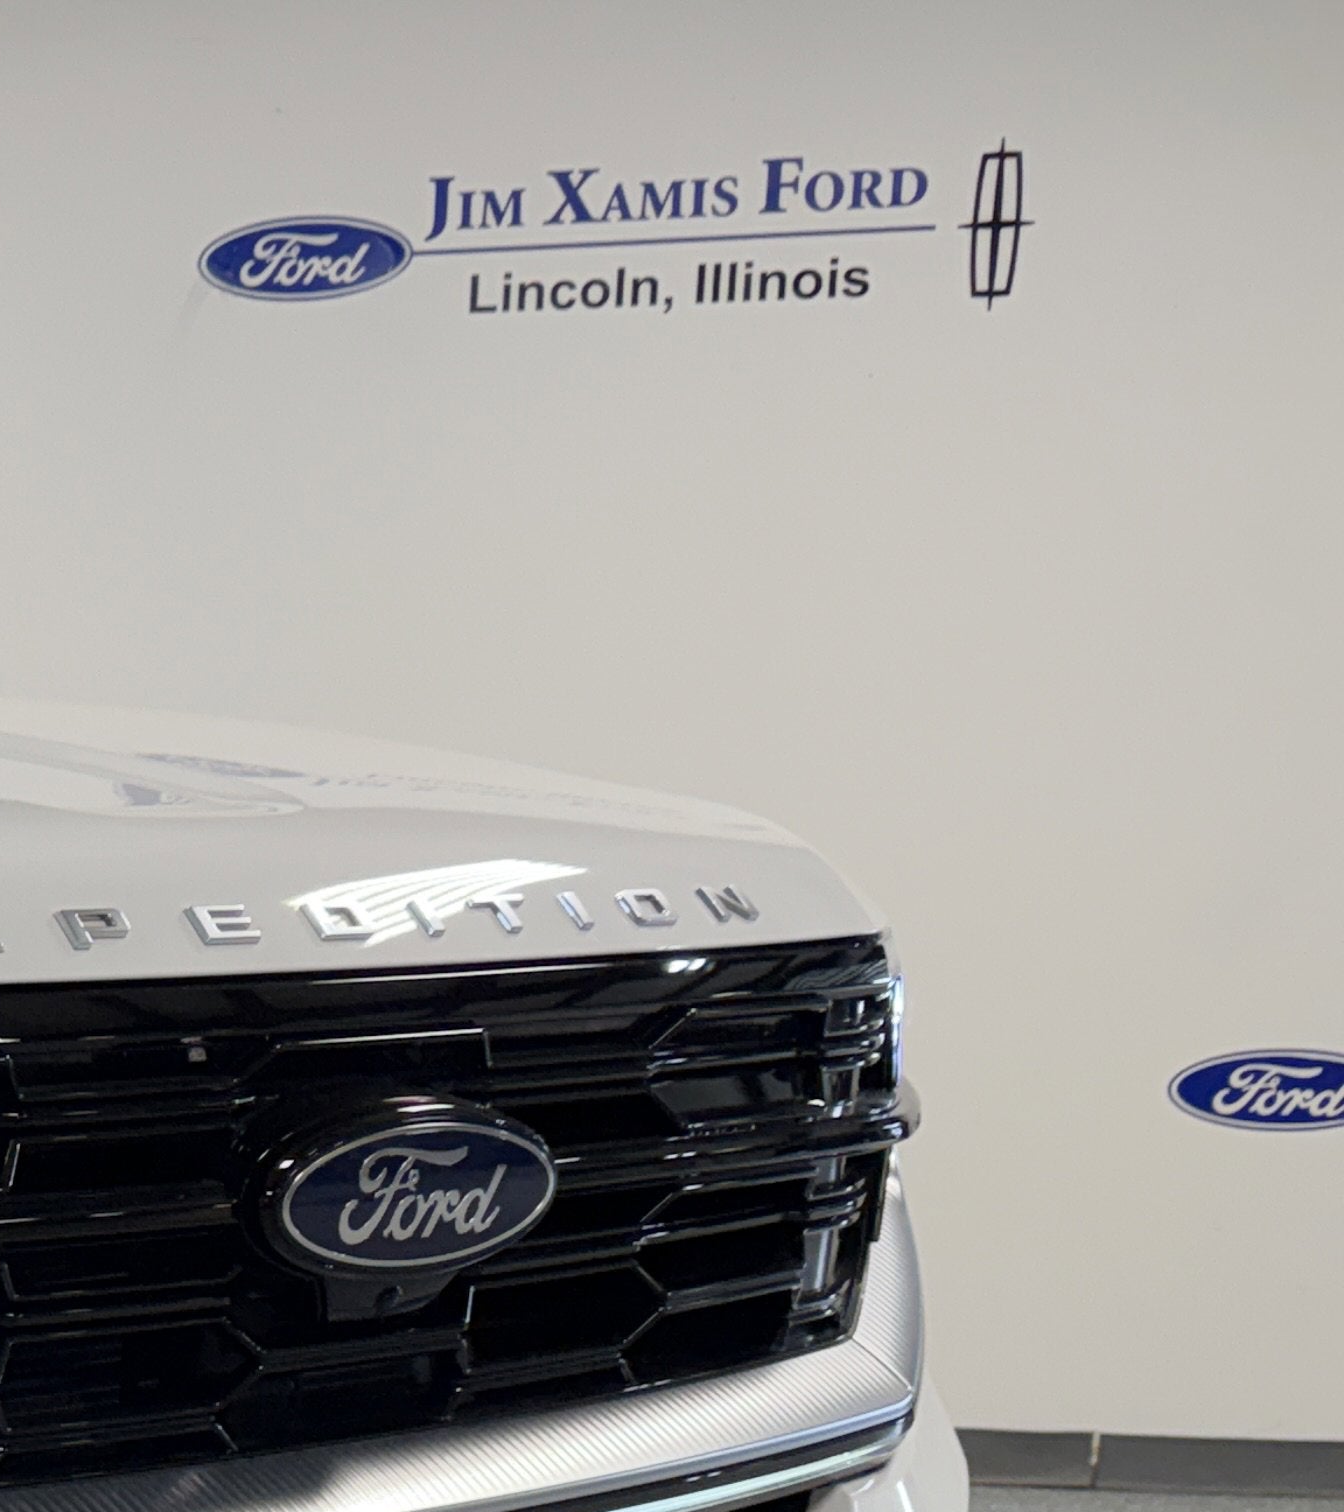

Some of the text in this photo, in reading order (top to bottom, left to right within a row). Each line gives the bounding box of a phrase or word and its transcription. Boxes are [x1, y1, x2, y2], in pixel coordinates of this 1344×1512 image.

[425, 156, 929, 241] JIM XAMIS FORD
[239, 232, 370, 288] Ford
[469, 256, 869, 314] Lincoln, Illinois
[337, 1144, 501, 1246] Ford
